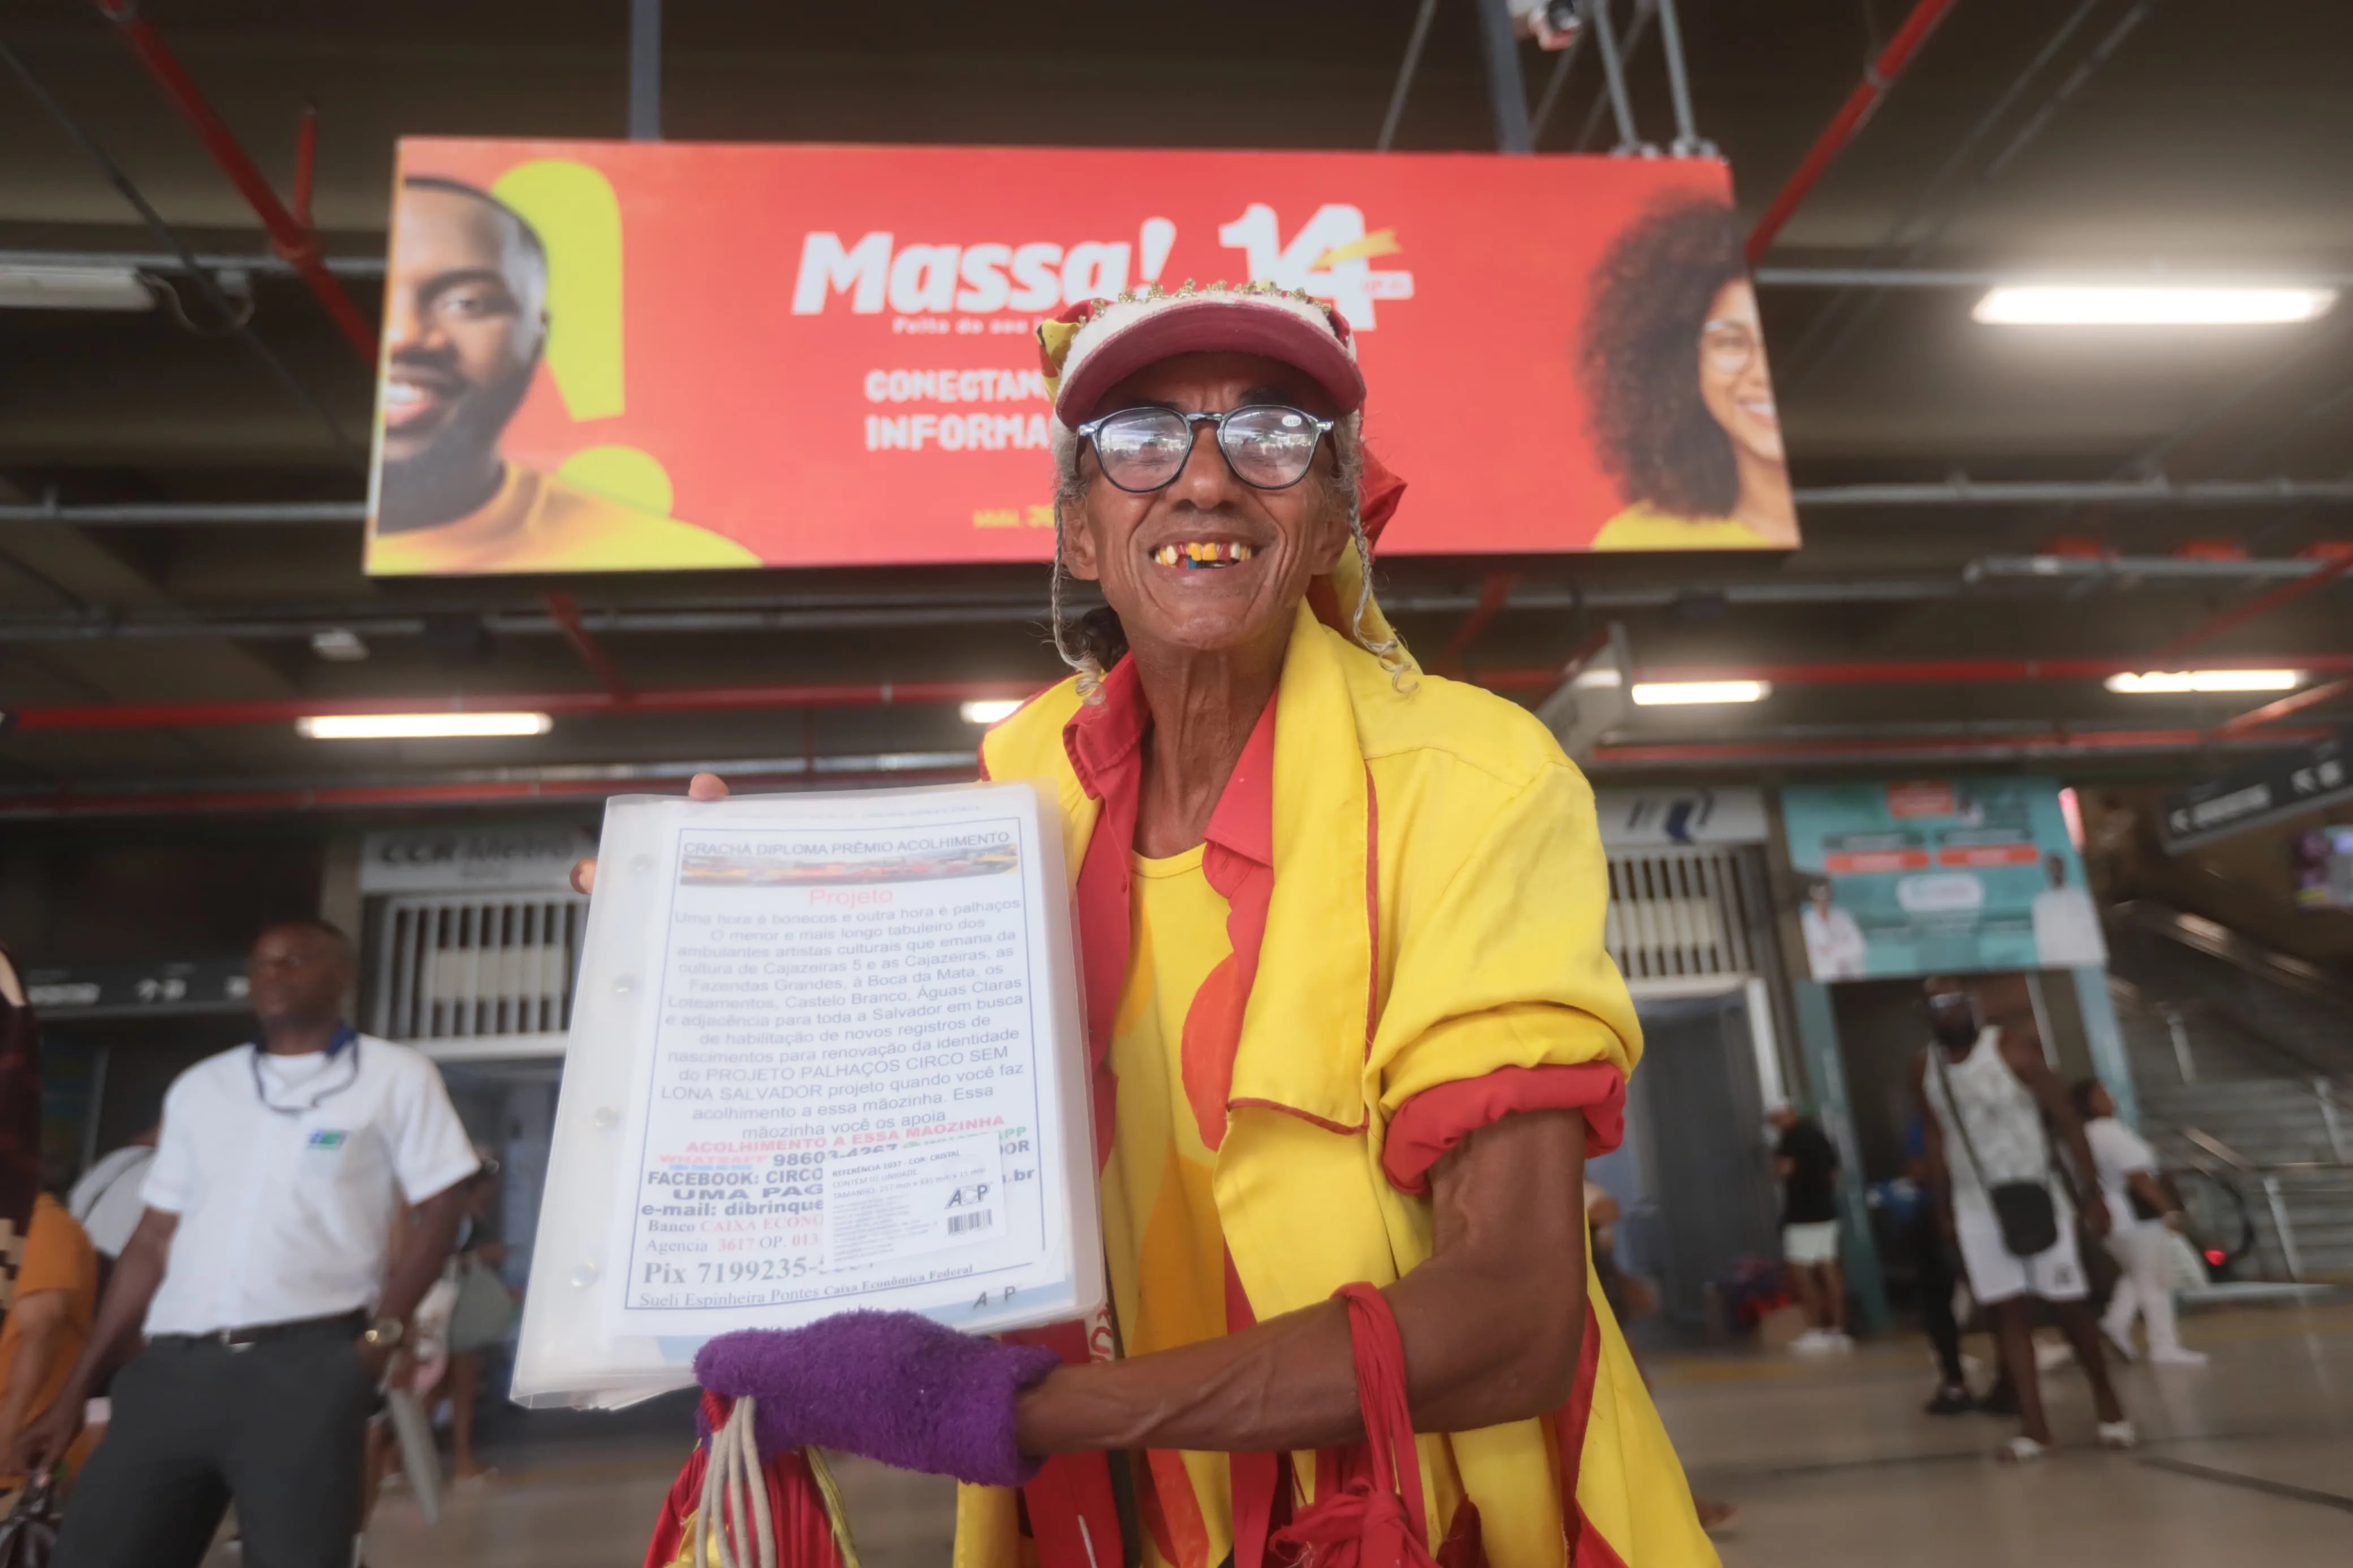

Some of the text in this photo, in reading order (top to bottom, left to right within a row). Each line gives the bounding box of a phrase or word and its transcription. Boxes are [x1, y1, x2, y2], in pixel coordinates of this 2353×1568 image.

[792, 217, 1175, 315] Massa!
[1218, 202, 1413, 331] 14
[865, 413, 1051, 451] INFORMA
[684, 832, 1010, 855] CRACHÁ DIPLOMA PRÊMIO ACOLHIMENTO
[809, 888, 893, 908] Projeto
[675, 912, 712, 925] Uma
[718, 912, 752, 925] hora
[772, 913, 837, 925] bonecos
[842, 913, 851, 922] e
[856, 910, 895, 922] outra
[900, 905, 934, 919] hora
[953, 900, 1020, 916] palhaços
[711, 917, 985, 941] O menor e mais longo tabuleiro dos
[678, 930, 1016, 958] ambulantes artistas culturais que emana da
[679, 947, 1014, 977] cultura de Cajazeiras 5 e as Cajazeiras, as
[689, 978, 769, 992] Fazendas
[775, 978, 846, 992] Grandes,
[868, 974, 907, 987] Boca
[912, 971, 931, 983] da
[937, 967, 979, 980] Mata,
[985, 964, 1003, 975] os
[786, 994, 846, 1008] Castelo
[851, 991, 911, 1005] Branco,
[917, 985, 967, 1001] Águas
[972, 978, 1022, 994] Claras
[665, 995, 1023, 1029] e adjacência para toda a Salvador em busca
[700, 1016, 991, 1047] de habilitação de novos registros de
[669, 1028, 1019, 1065] nascimentos para renovação da identidade
[679, 1046, 1008, 1082] do PROJETO PALHAÇOS CIRCO SEM
[661, 1063, 1024, 1100] LONA SALVADOR projeto quando você faz
[693, 1086, 993, 1120] acolhimento a essa mãozinha. Essa
[743, 1111, 946, 1139] mãozinha você os apoia
[686, 1137, 827, 1153] ACOLHIMENTO
[833, 1135, 846, 1147] A
[852, 1130, 900, 1144] ESSA
[833, 1163, 881, 1177] REFERÊNCIA
[930, 1150, 960, 1161] CRISTAL
[648, 1170, 759, 1186] FACEBOOK:
[673, 1189, 749, 1200] UMA
[641, 1202, 717, 1216] e-mail:
[648, 1220, 695, 1232] Banco
[700, 1219, 757, 1233] CAIXA
[646, 1238, 708, 1255] Agencia
[718, 1238, 756, 1252] 3617
[760, 1236, 787, 1249] OP.
[639, 1264, 973, 1307] Sueli Espinheira Pontes Caixa Econômica Federal
[643, 1262, 686, 1284] Pix
